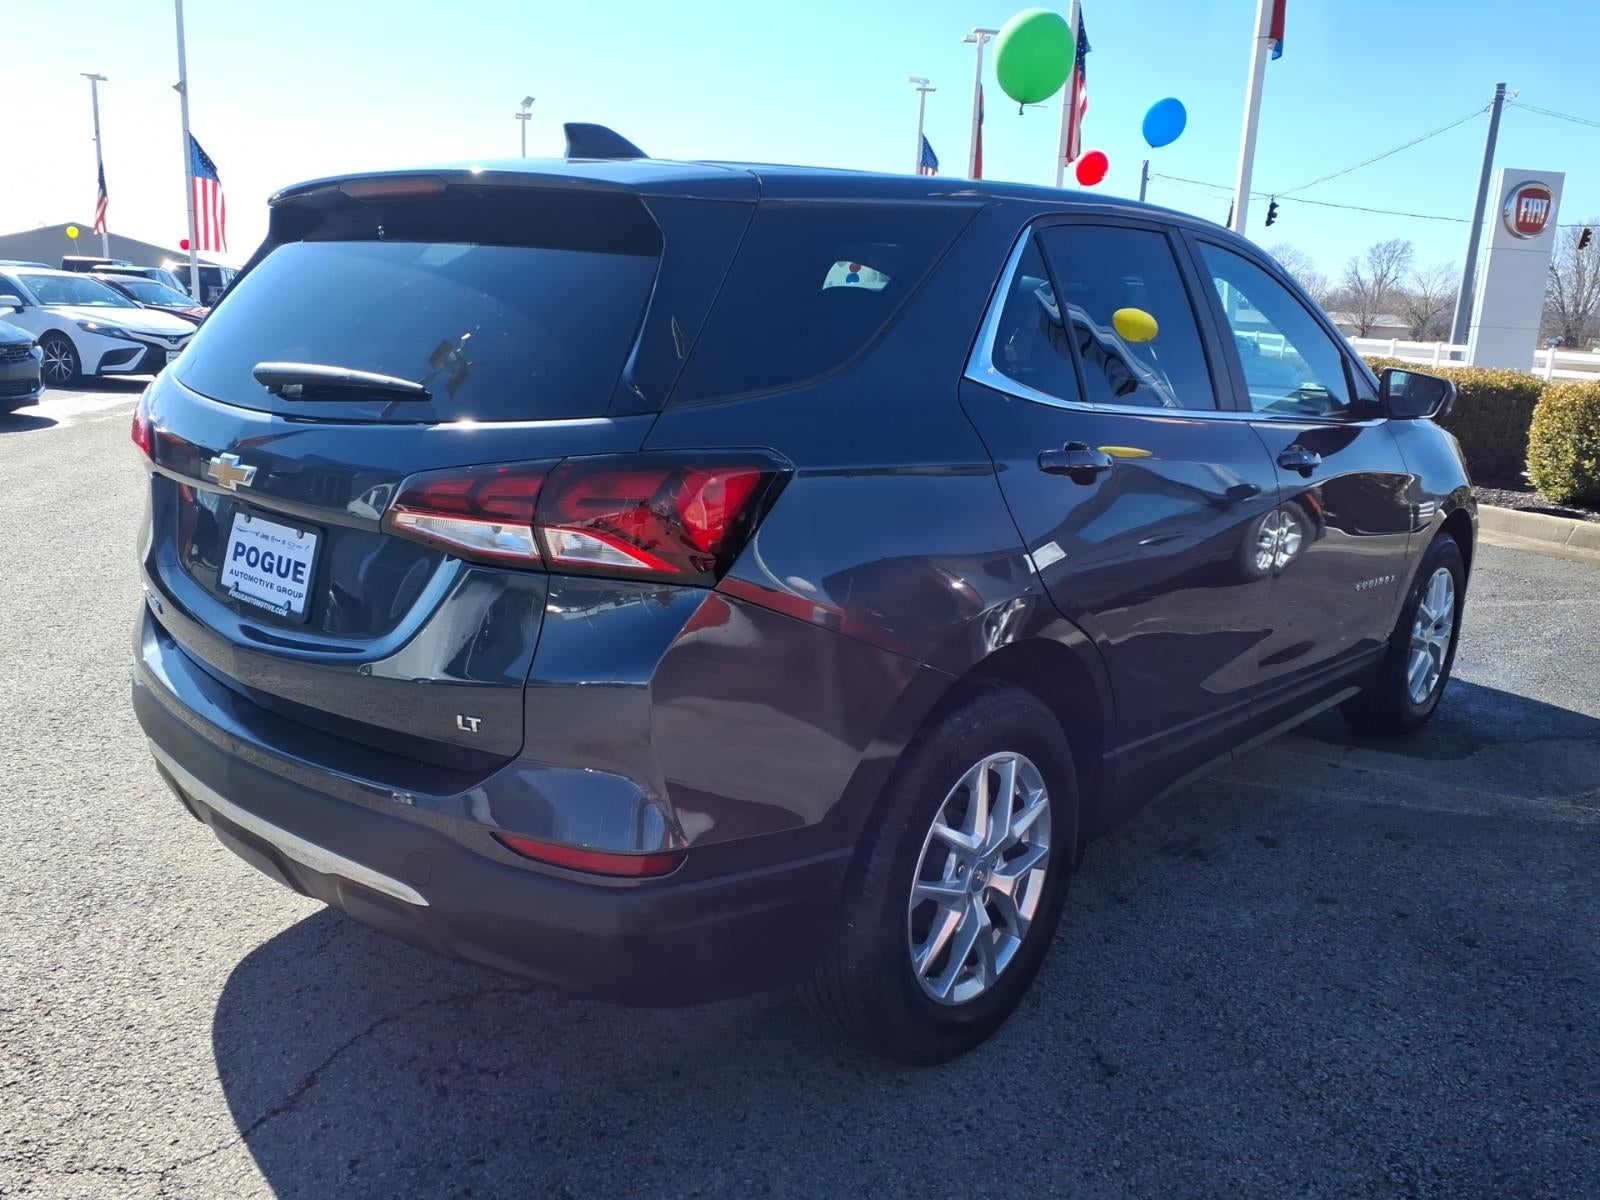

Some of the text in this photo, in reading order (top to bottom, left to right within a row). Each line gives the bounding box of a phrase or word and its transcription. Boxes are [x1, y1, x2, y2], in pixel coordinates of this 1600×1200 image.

[1518, 197, 1550, 224] FIAT
[232, 541, 307, 585] POGUE
[229, 568, 304, 600] AUTOMOTIVE GROUP
[456, 714, 482, 733] LT
